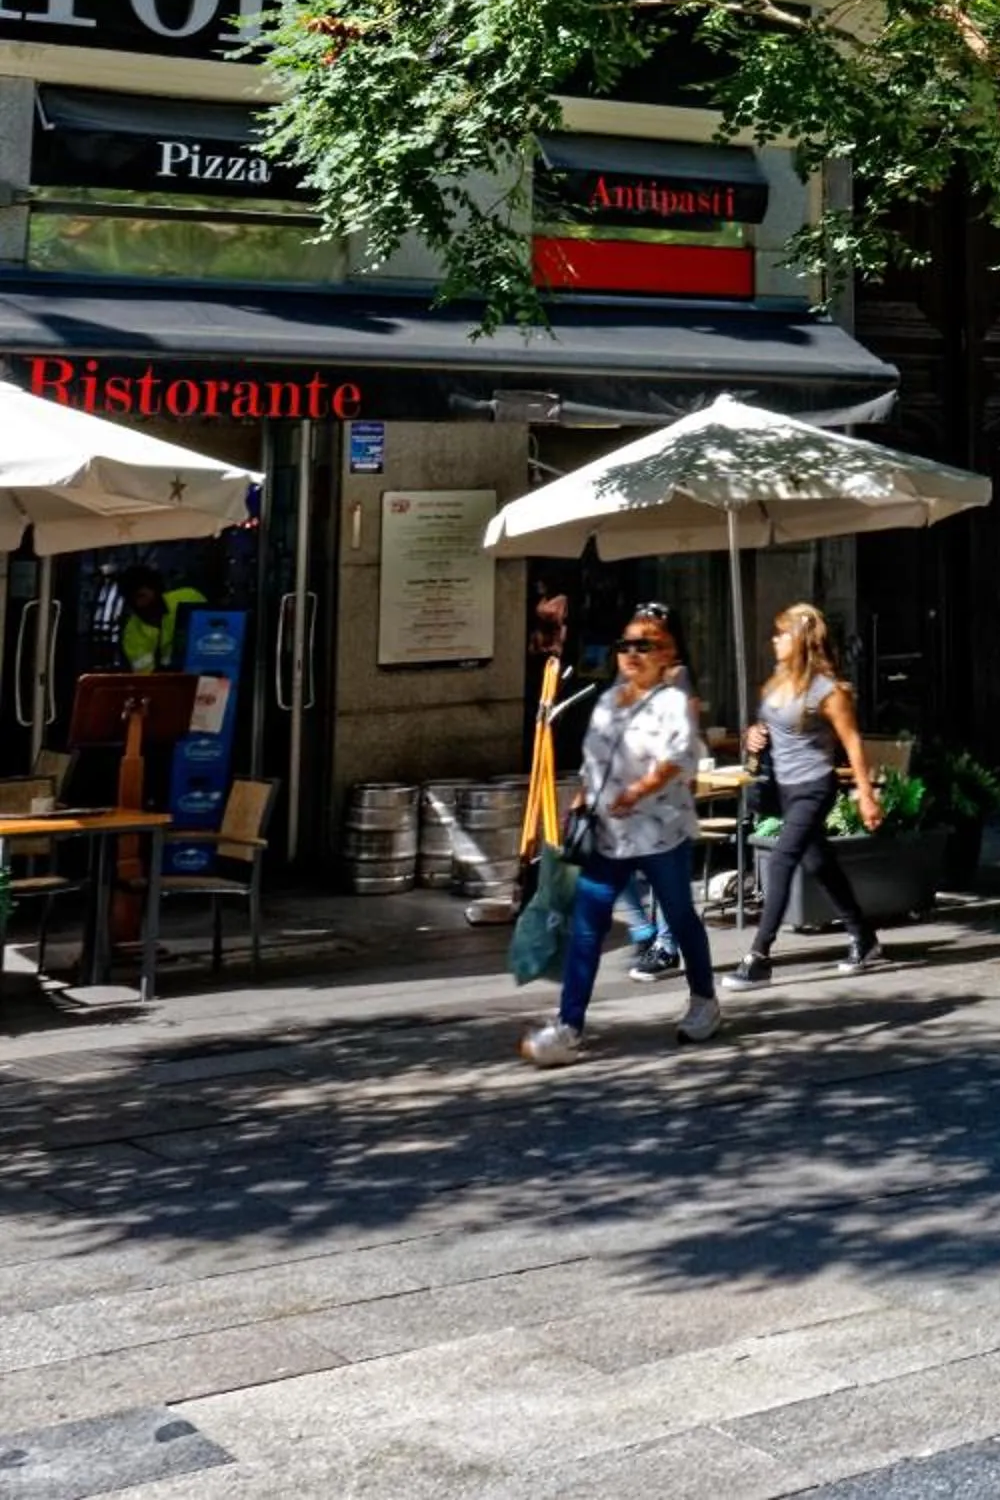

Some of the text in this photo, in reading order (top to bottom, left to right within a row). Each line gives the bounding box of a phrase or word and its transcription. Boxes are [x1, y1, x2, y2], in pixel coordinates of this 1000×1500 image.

[156, 141, 272, 183] Pizza
[588, 175, 735, 218] Antipasti
[26, 356, 363, 420] Ristorante
